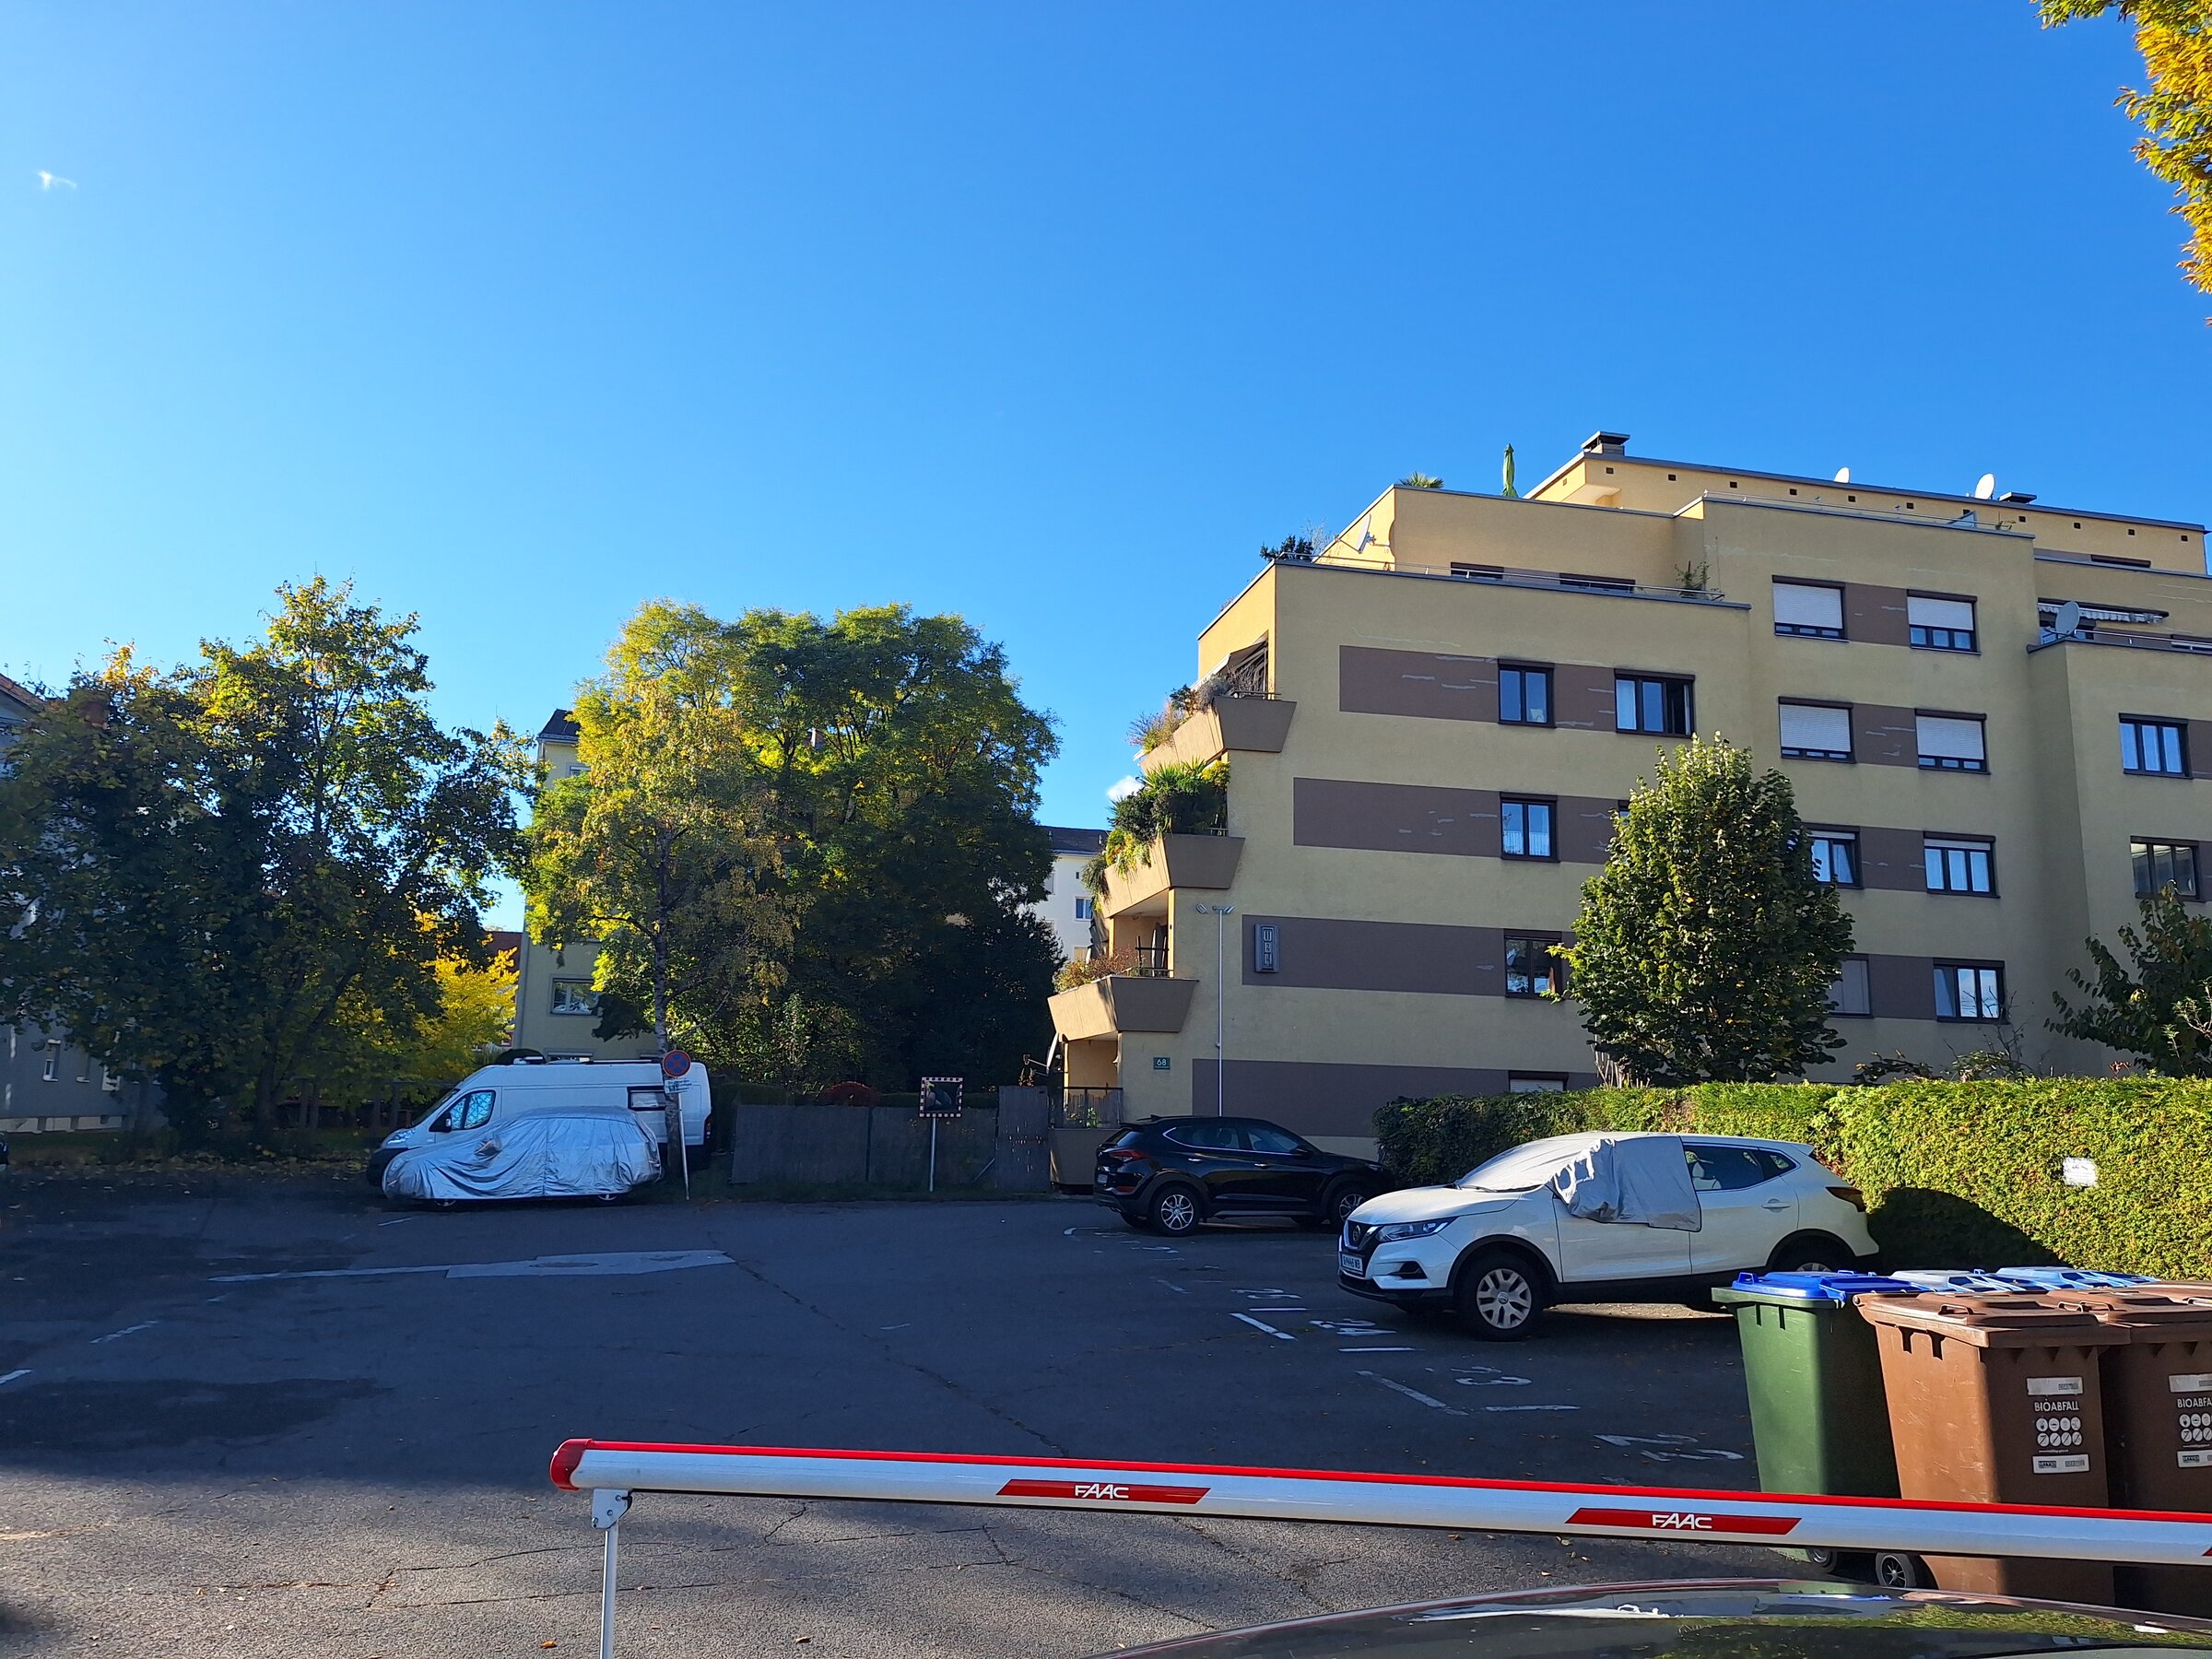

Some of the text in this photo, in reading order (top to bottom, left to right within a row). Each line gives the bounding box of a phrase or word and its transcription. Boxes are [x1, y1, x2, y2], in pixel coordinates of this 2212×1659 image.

[1156, 1058, 1167, 1066] 68
[2034, 1400, 2080, 1412] BIOABFALL
[1074, 1483, 1129, 1499] FAAC
[1652, 1512, 1712, 1529] FAAC
